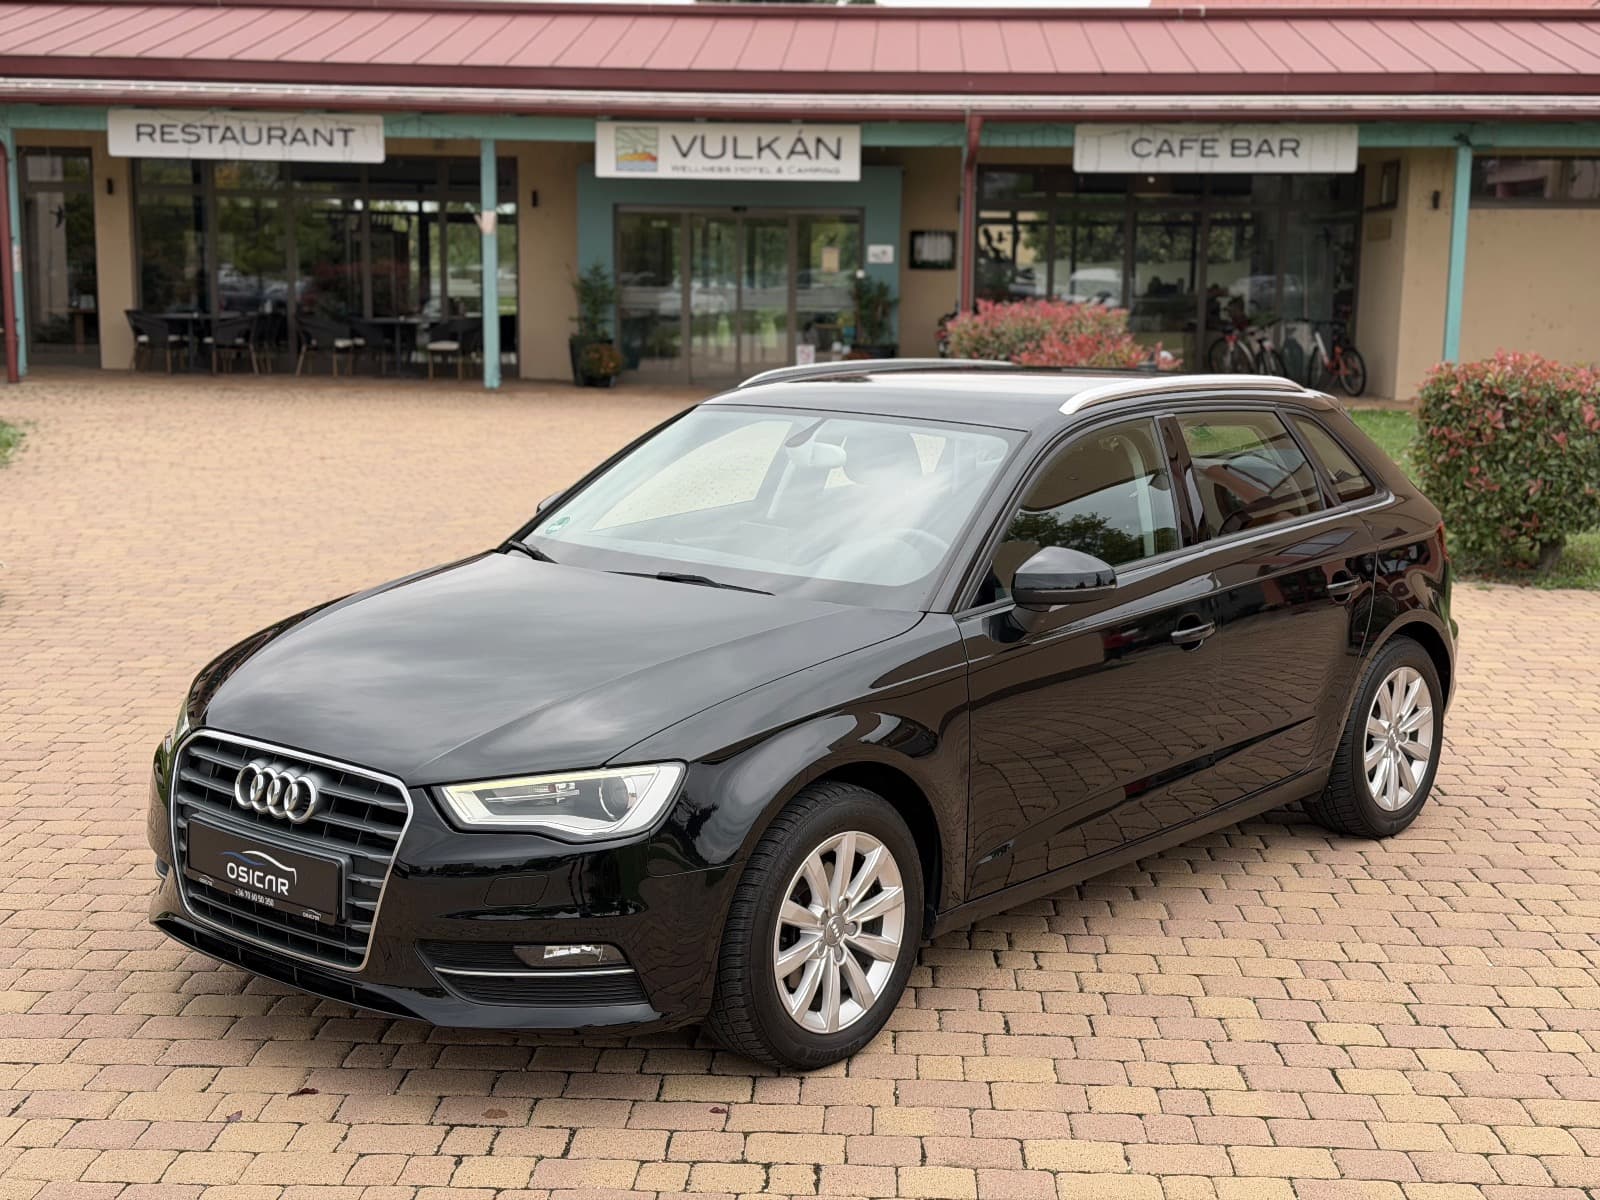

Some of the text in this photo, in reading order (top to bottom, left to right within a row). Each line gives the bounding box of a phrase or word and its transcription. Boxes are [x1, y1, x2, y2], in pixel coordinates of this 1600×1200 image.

[135, 123, 355, 147] RESTAURANT
[671, 129, 842, 160] VULKÁN
[1131, 138, 1301, 158] CAFE BAR
[226, 862, 289, 895] OSICAR
